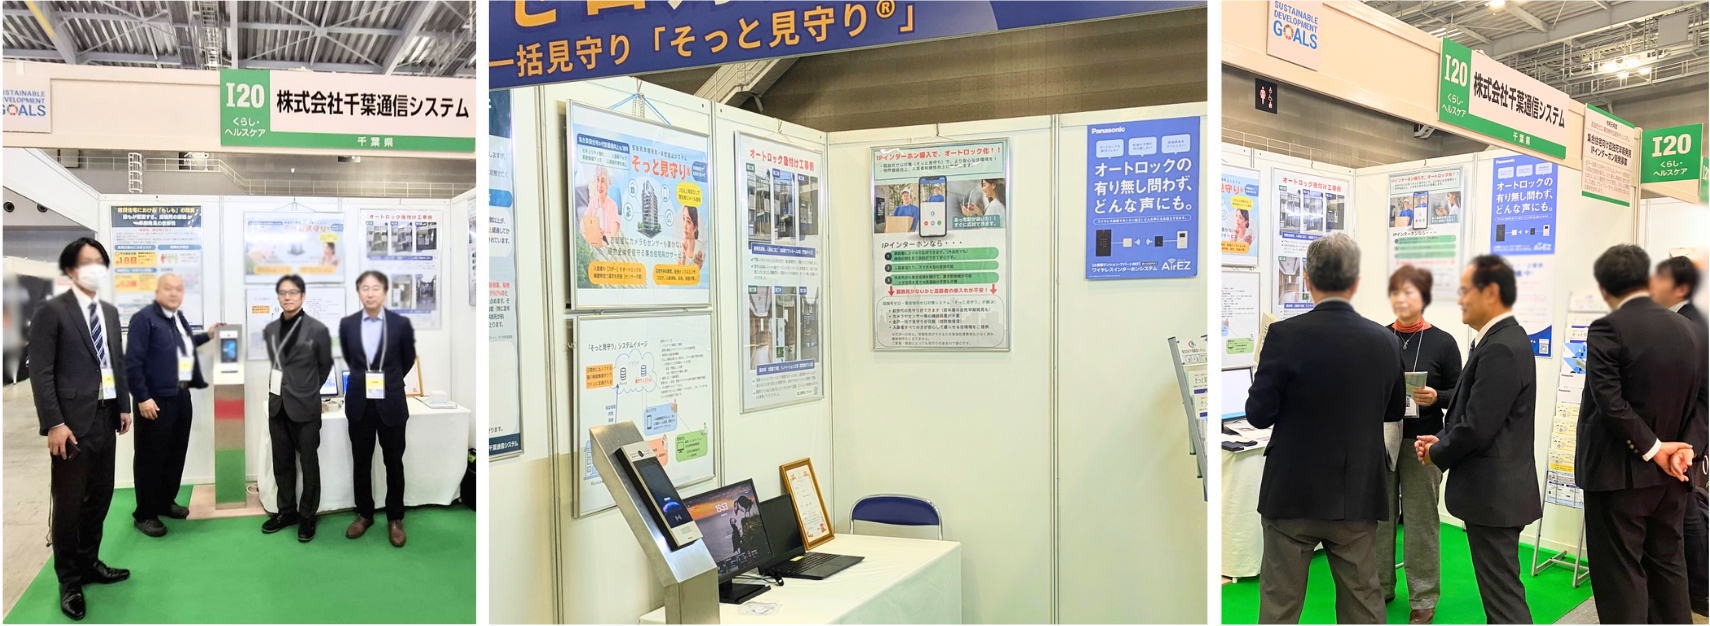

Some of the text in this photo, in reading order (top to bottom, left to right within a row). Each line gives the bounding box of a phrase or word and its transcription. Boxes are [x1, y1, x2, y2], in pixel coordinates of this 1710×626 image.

[1274, 0, 1319, 25] SUSTAINABLE
[1274, 10, 1318, 33] DEVELOPMENT
[1273, 20, 1318, 49] GOALS
[1445, 54, 1468, 87] I20
[225, 82, 265, 109] I20
[276, 90, 470, 118] 株式会社千葉通信システム
[1474, 72, 1565, 128] 株式会社千葉通信システム
[1441, 103, 1466, 118] ヘルスケア
[225, 128, 266, 137] ヘルスケア
[1091, 126, 1125, 134] Panasonic
[1513, 132, 1531, 145] 千葉県
[357, 137, 394, 147] 千葉県
[1652, 134, 1692, 157] I20
[1095, 158, 1192, 177] オートロックの
[1653, 168, 1688, 177] ヘルスケア
[1094, 175, 1192, 196] 有り無し問わず、
[1496, 177, 1553, 191] オートロックの
[1094, 195, 1192, 214] どんな声にも。
[1496, 189, 1553, 203] 有り無し問わず、
[1496, 202, 1552, 215] どんな声にも。
[1161, 260, 1191, 271] AirEZ
